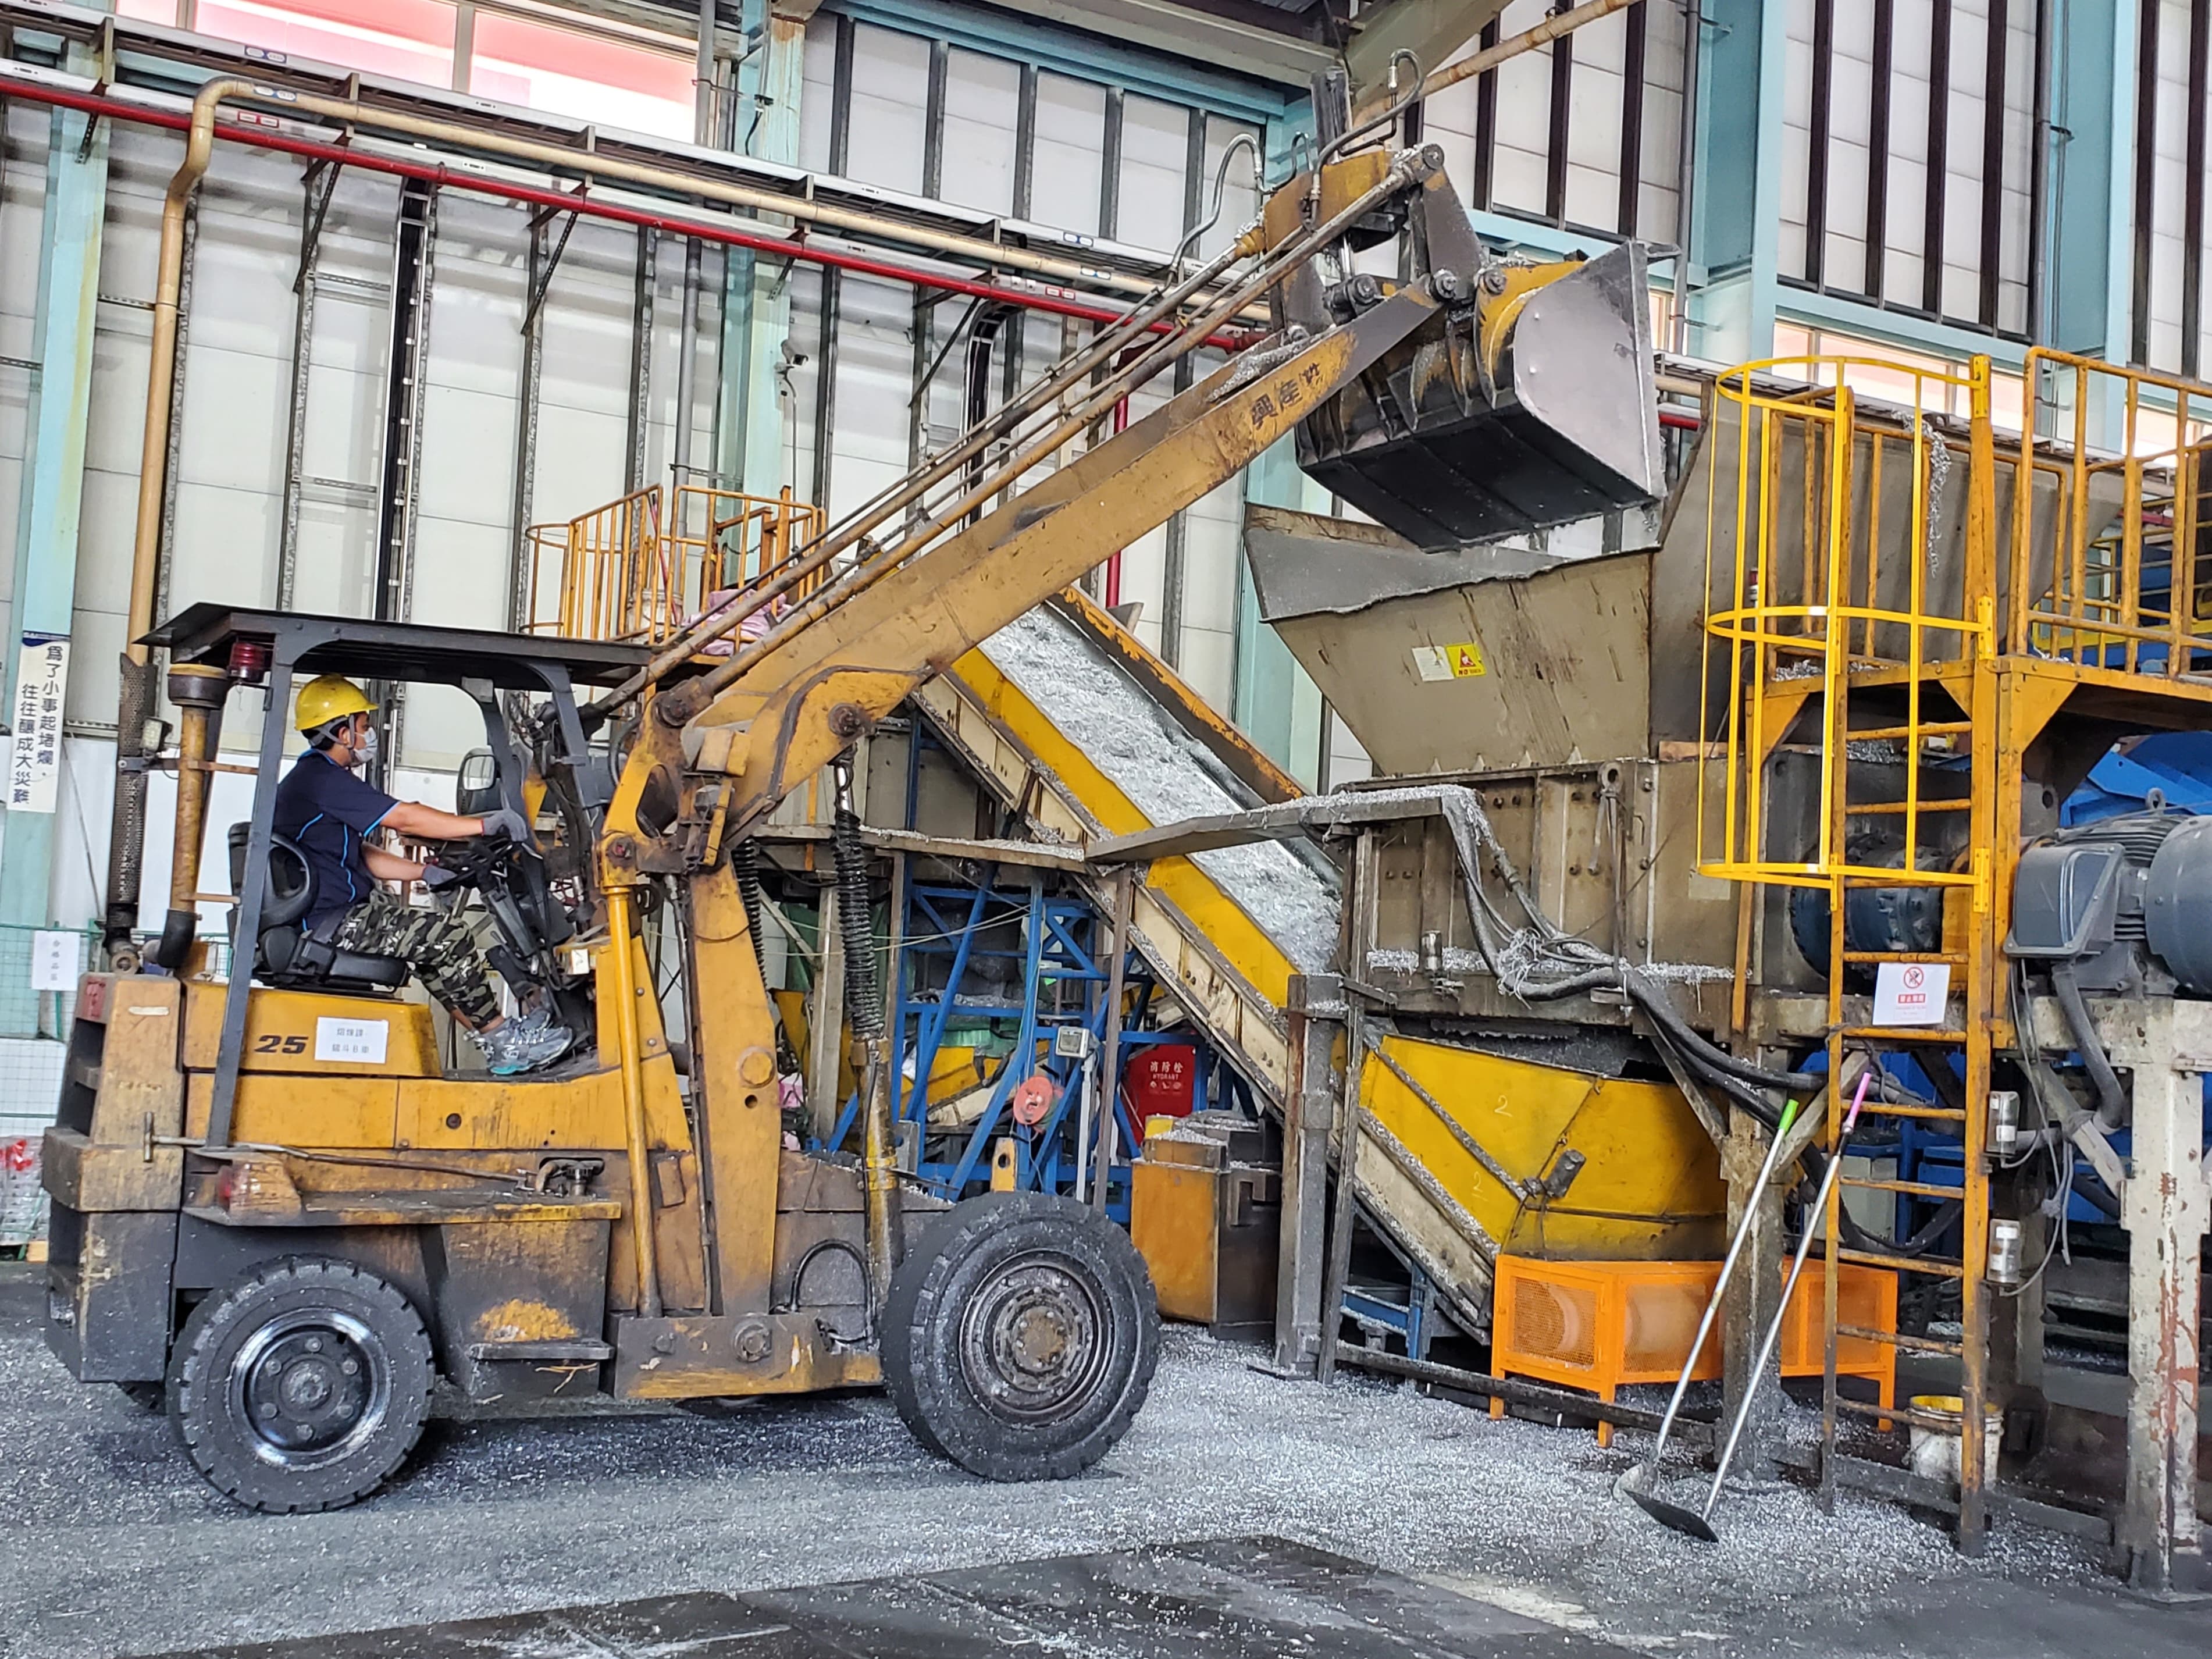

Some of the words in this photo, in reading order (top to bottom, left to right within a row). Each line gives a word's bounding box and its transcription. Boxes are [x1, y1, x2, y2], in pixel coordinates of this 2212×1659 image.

[254, 1035, 309, 1054] 25
[1150, 1060, 1184, 1073] 消防栓
[1494, 1095, 1513, 1117] 2
